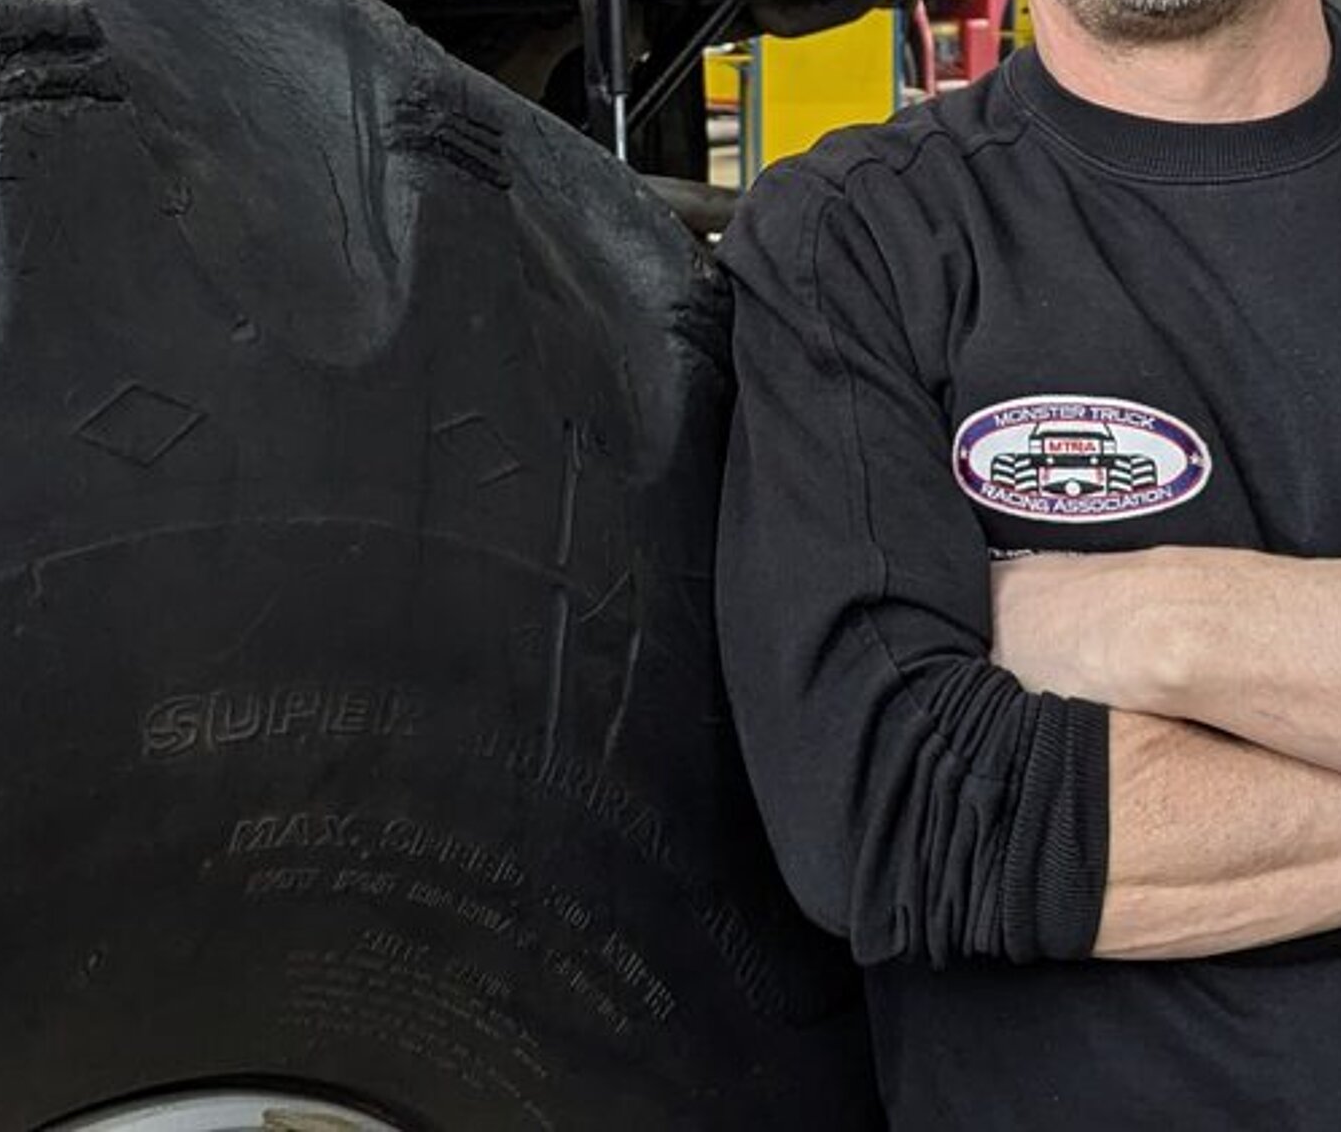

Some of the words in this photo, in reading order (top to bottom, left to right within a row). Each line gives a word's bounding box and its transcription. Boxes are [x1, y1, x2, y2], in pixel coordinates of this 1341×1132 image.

[993, 403, 1085, 428] MONSTER
[1091, 405, 1156, 431] TRUCK
[980, 484, 1051, 513] RACING
[1053, 485, 1173, 514] ASSOCIATION
